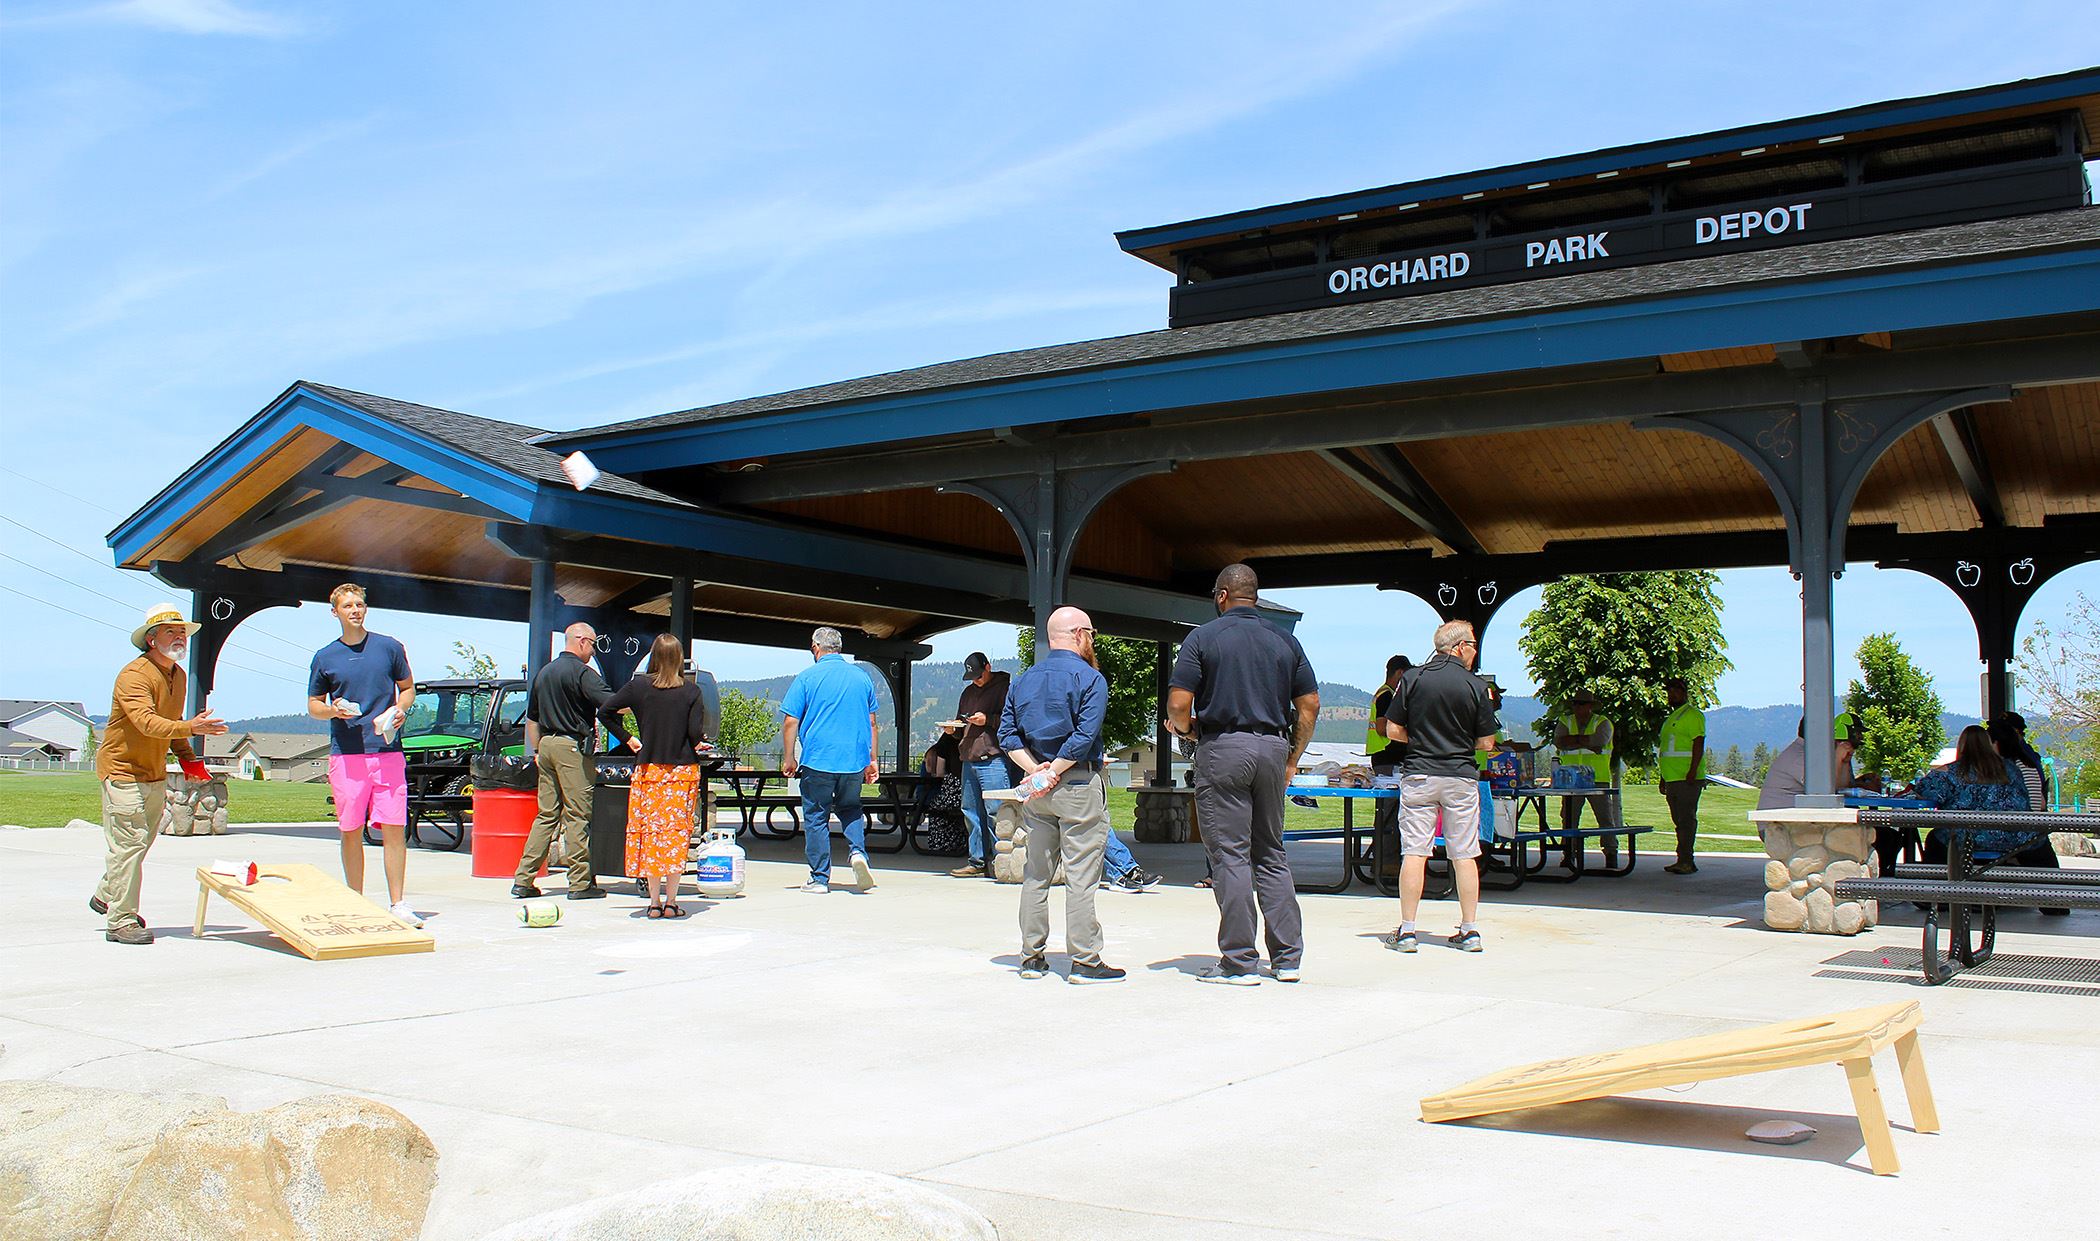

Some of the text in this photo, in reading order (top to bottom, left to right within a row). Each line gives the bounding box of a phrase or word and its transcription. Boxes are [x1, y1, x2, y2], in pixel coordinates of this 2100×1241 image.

[1328, 203, 1812, 294] ORCHARD PARK DEPOT
[303, 920, 408, 937] trailhead
